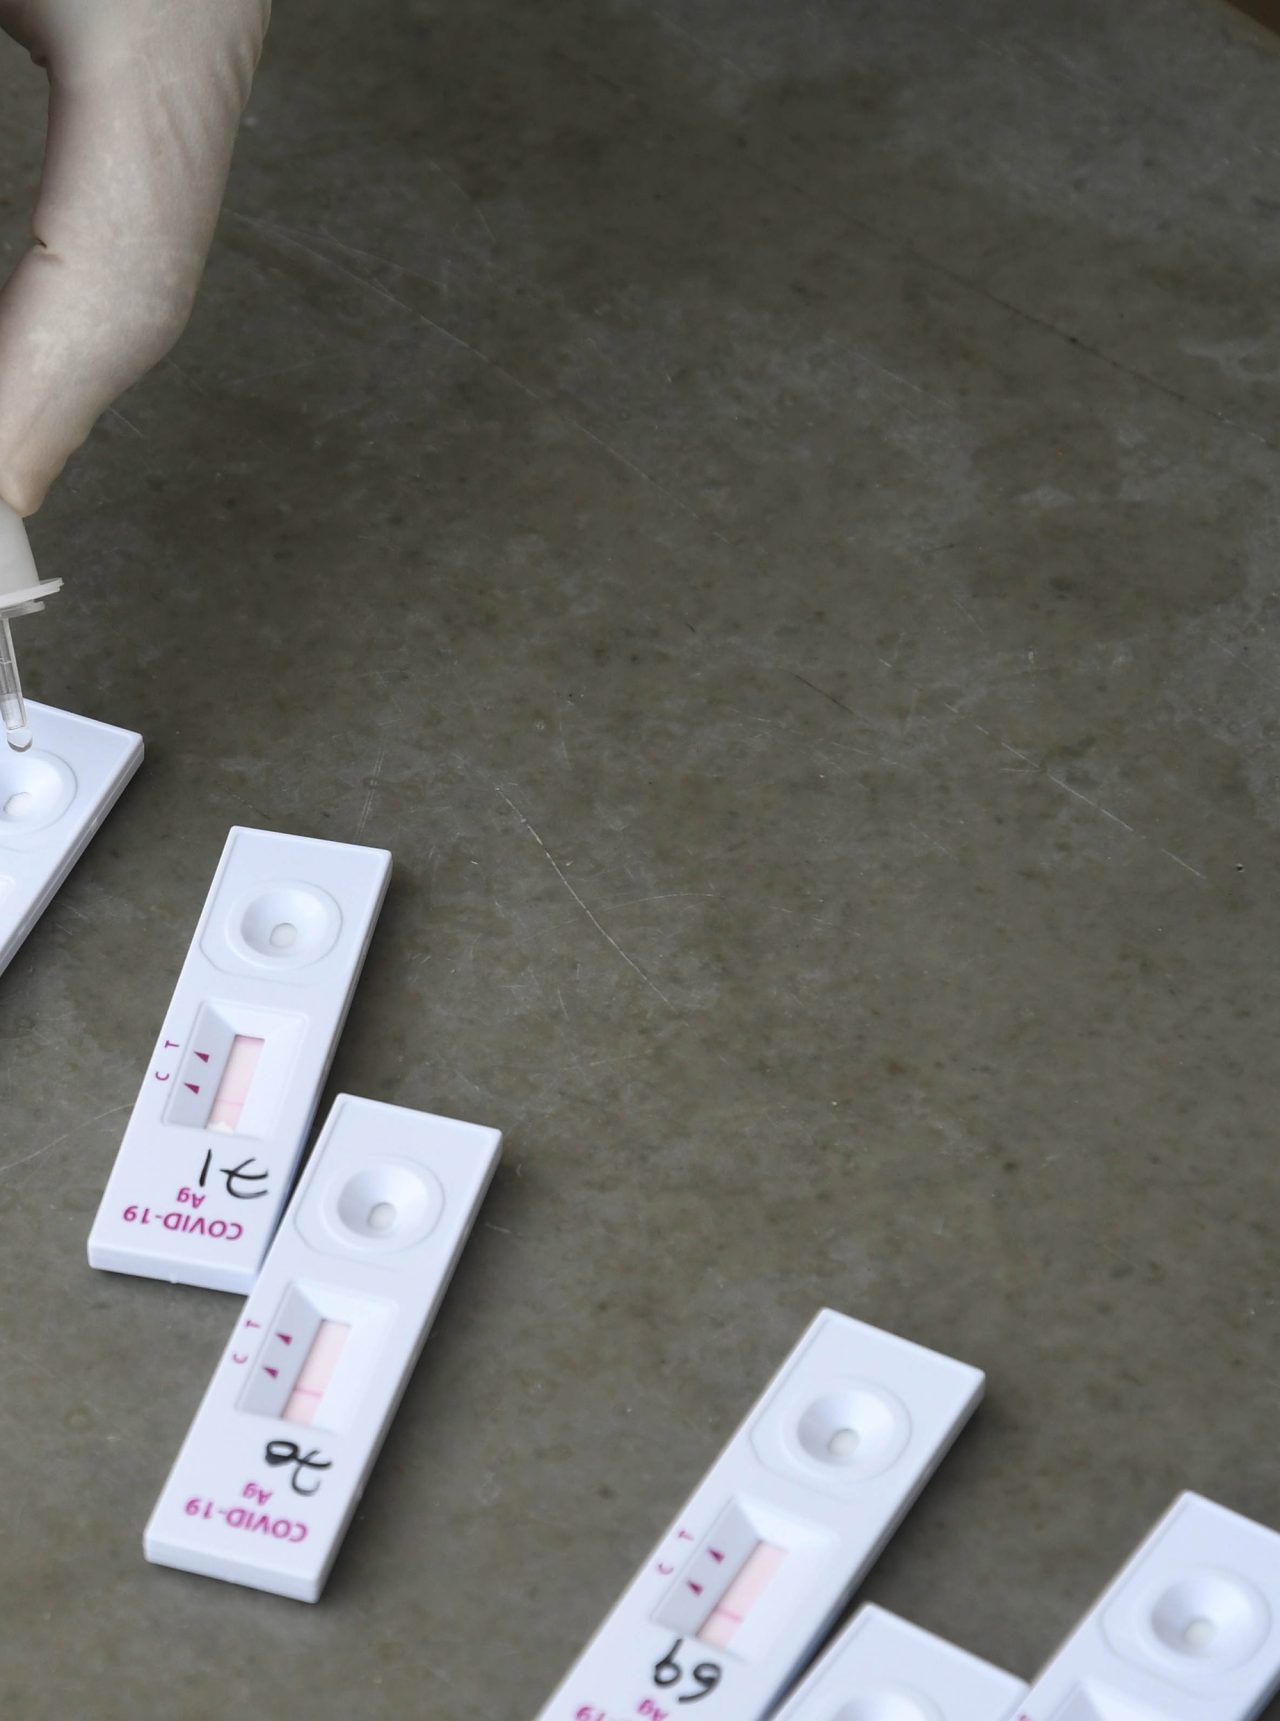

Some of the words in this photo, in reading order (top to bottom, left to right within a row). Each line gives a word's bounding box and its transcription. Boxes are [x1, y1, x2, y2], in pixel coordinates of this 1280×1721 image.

[163, 1039, 181, 1050] T
[154, 1070, 171, 1082] C
[199, 1149, 269, 1200] 71
[176, 1187, 206, 1209] Ag
[123, 1205, 244, 1240] COVID-19
[243, 1318, 262, 1330] T
[231, 1352, 249, 1365] C
[242, 1482, 273, 1505] Ag
[184, 1498, 308, 1542] COVID-19
[677, 1529, 694, 1542] T
[657, 1562, 674, 1575] C
